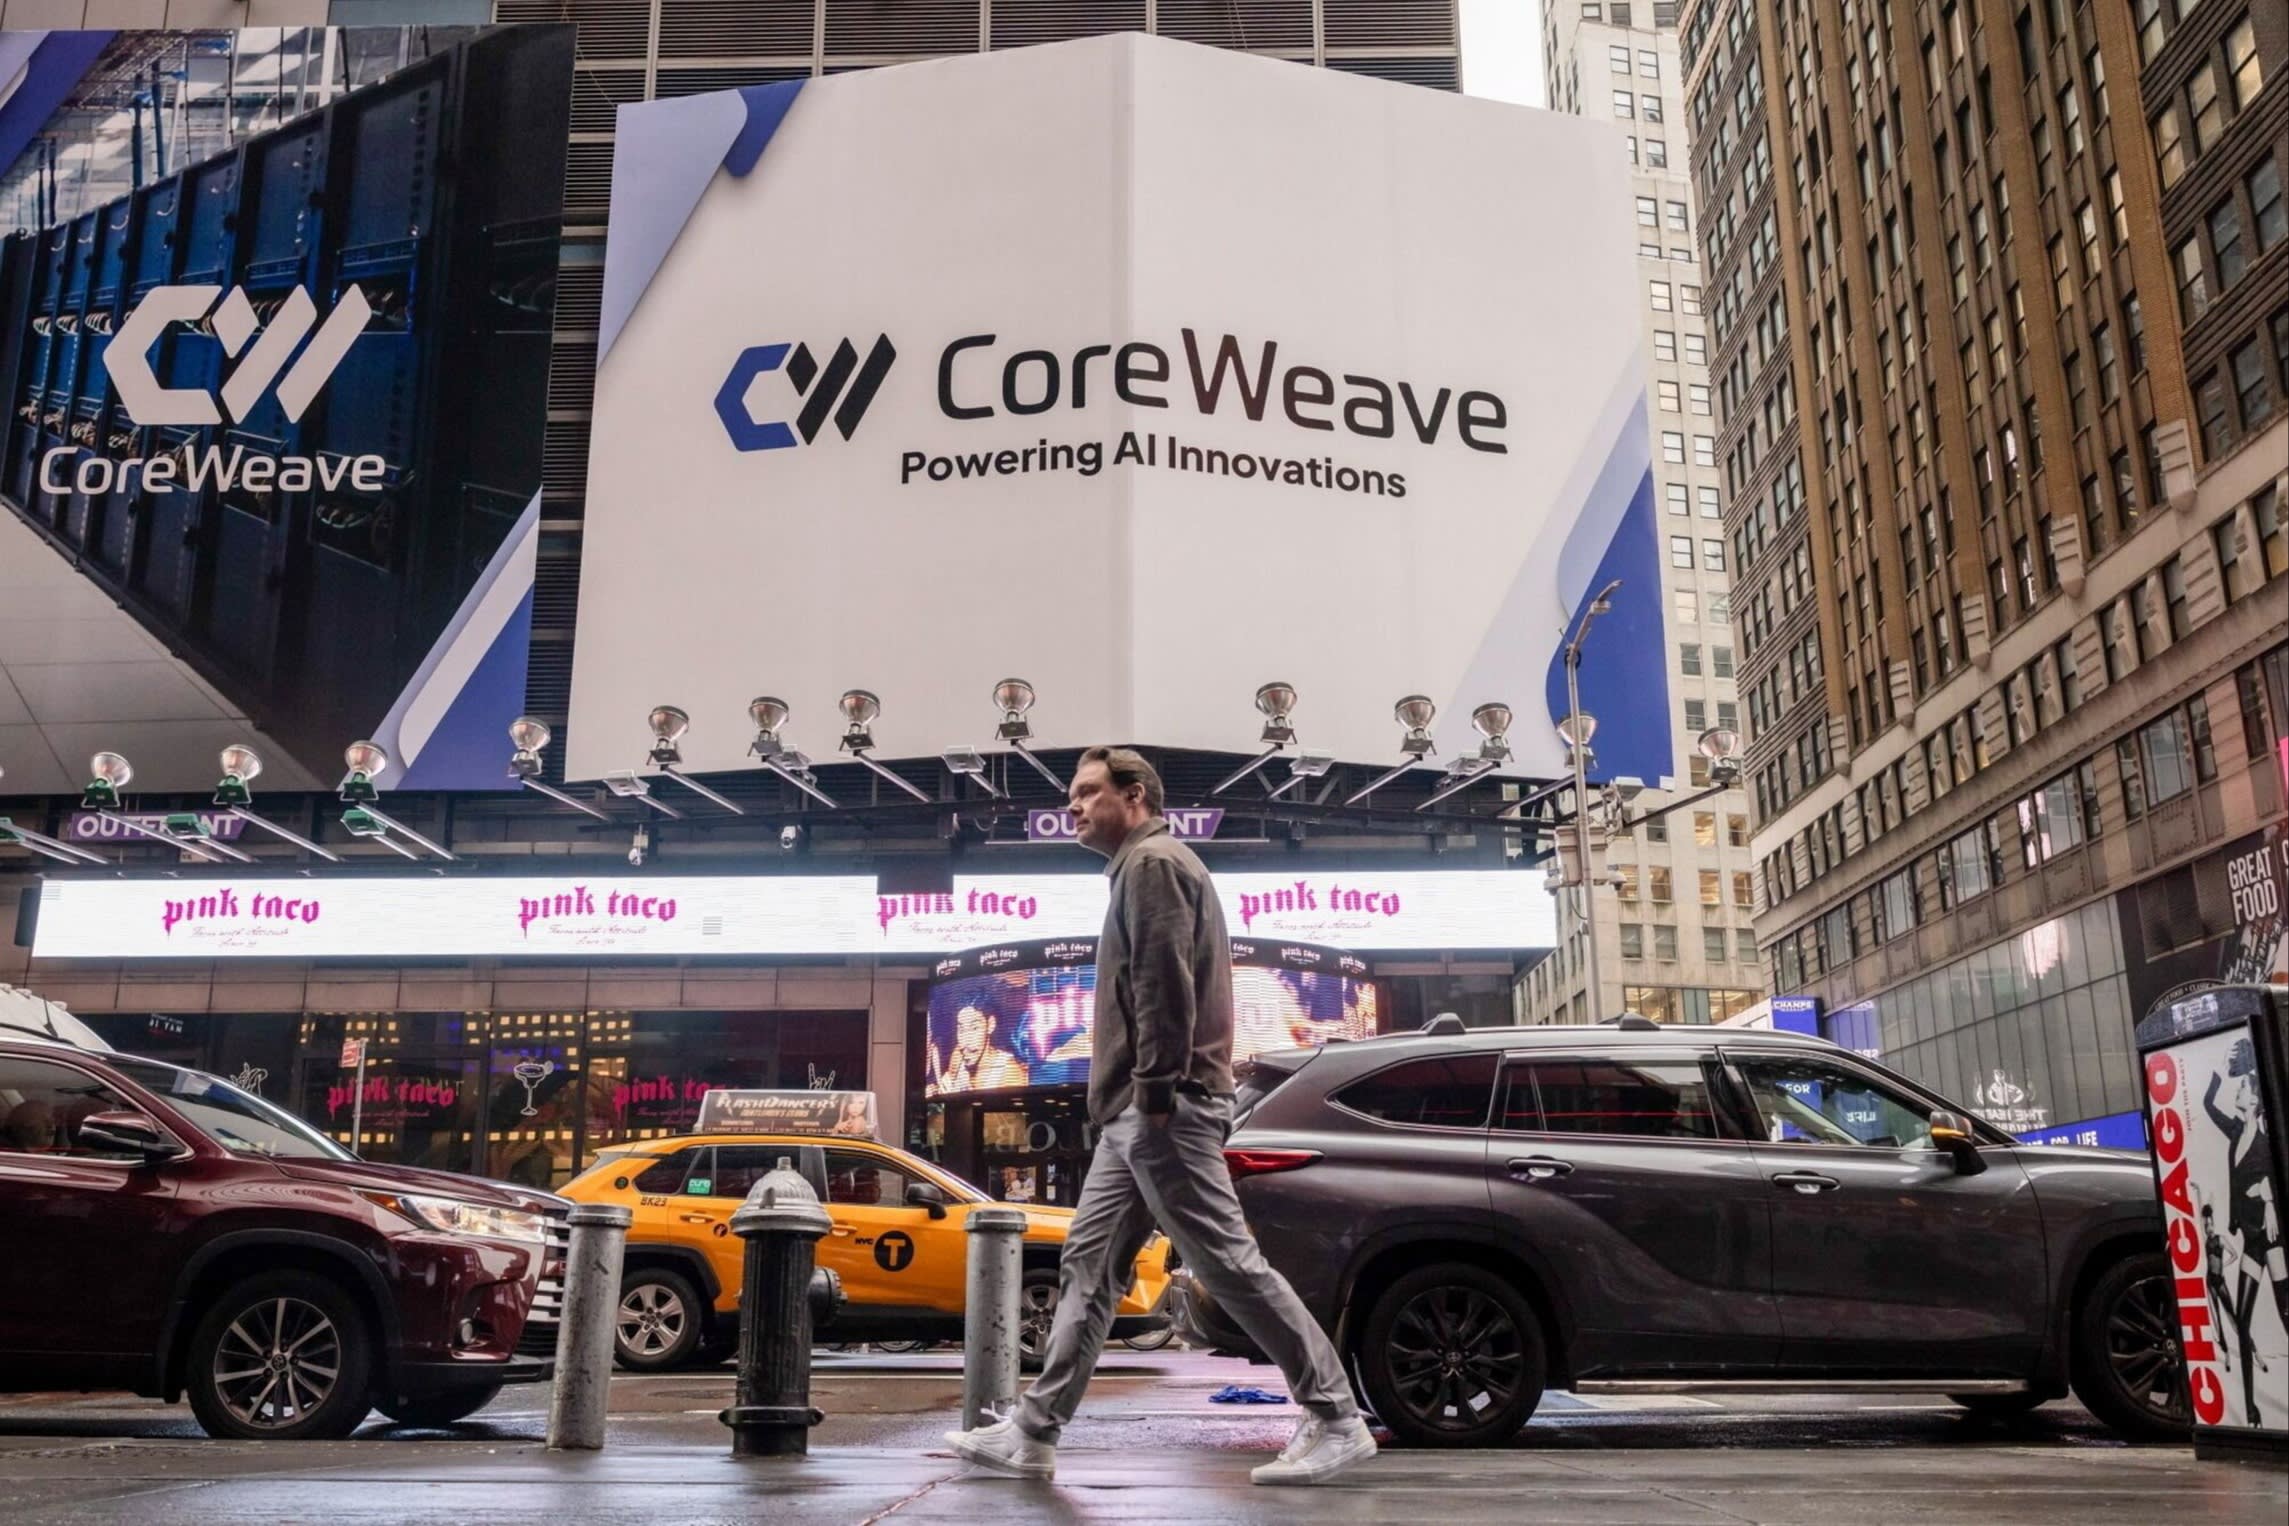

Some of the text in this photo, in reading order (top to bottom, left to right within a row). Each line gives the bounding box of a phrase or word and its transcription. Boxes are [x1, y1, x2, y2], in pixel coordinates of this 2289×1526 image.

[938, 328, 1508, 454] CoreWeave
[39, 444, 386, 495] CoreWeave
[901, 431, 1407, 498] Powering AI Innovations
[2227, 846, 2273, 890] GREAT
[162, 888, 320, 938] pink taco
[518, 886, 676, 939] pink taco
[968, 888, 1037, 919] taco
[1239, 880, 1400, 934] pink taco
[2232, 878, 2279, 926] FOOD
[612, 1075, 676, 1116] pink
[2146, 1052, 2225, 1426] CHICAGO
